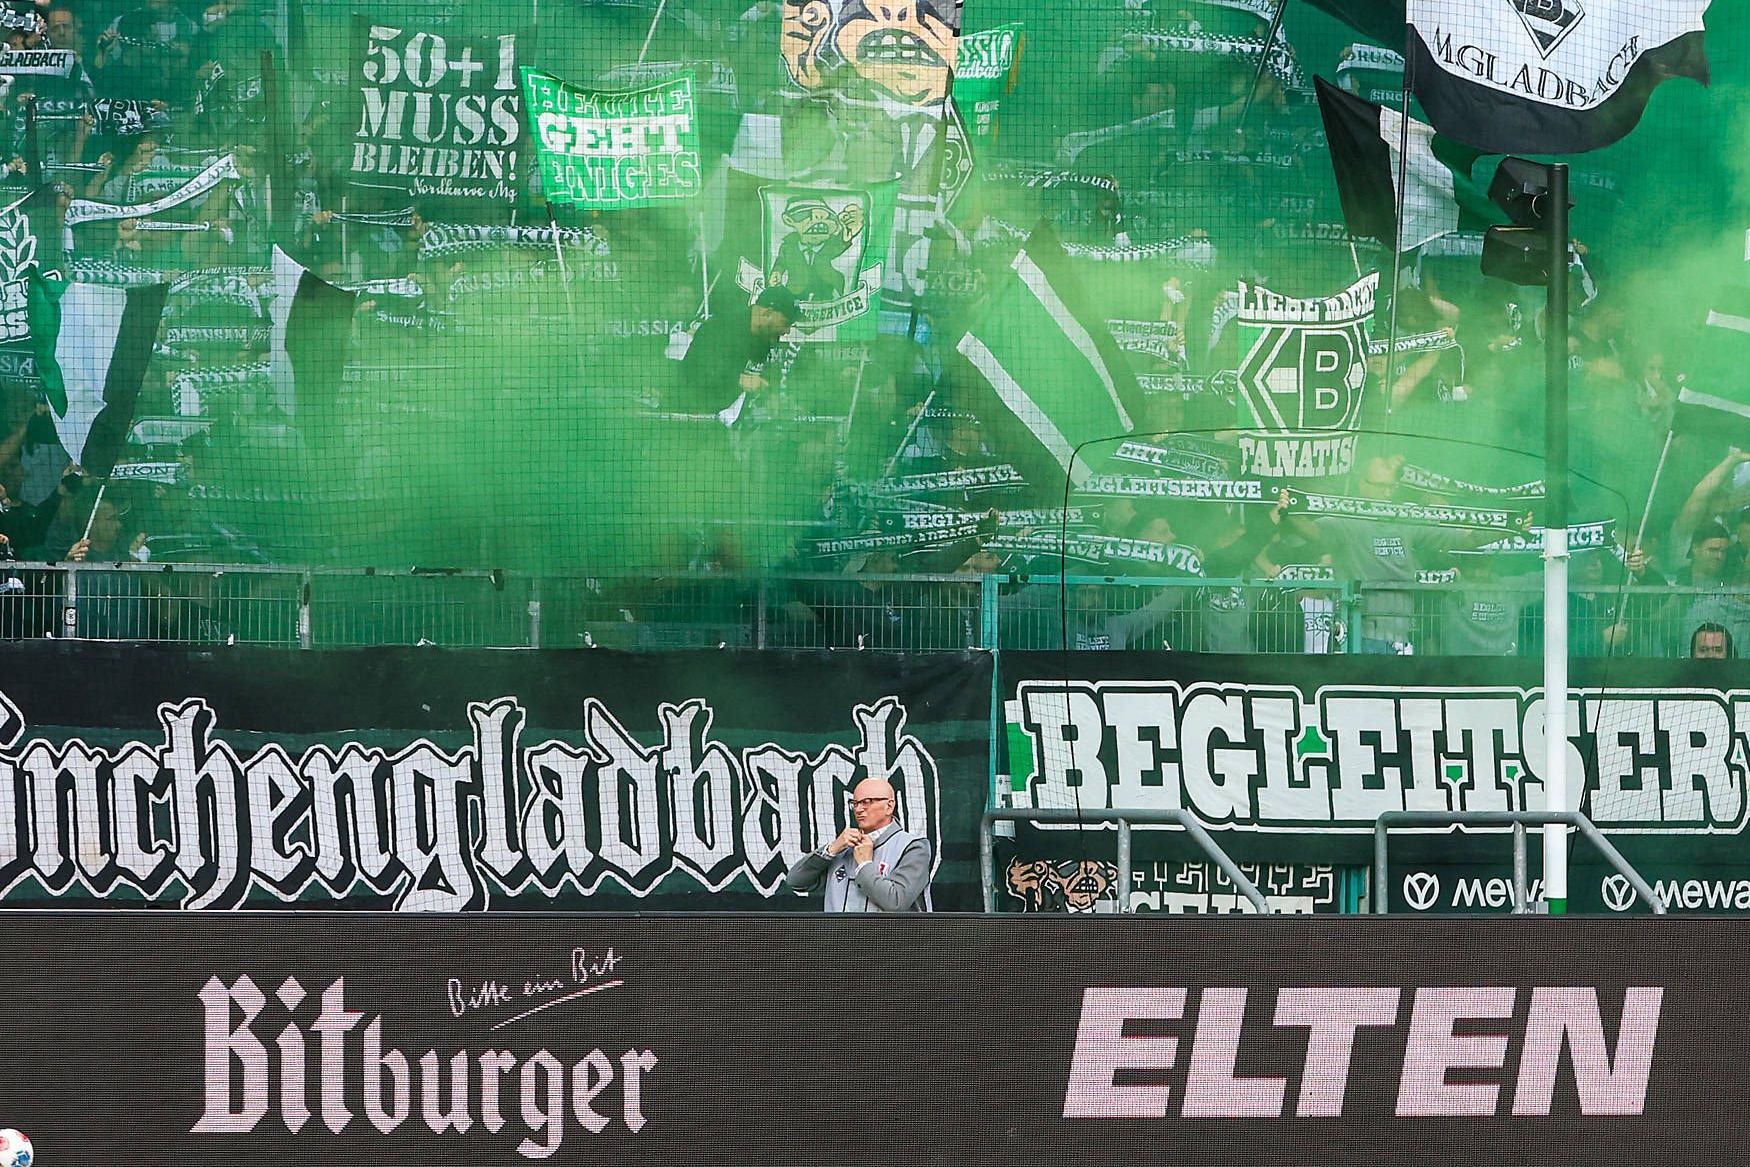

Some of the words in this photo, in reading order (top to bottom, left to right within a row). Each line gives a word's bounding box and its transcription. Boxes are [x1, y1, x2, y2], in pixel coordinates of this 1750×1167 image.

[362, 23, 519, 91] 50+1
[1431, 24, 1642, 109] M.GLADBACH
[353, 86, 521, 146] MUSS
[536, 114, 690, 153] GEHT
[350, 141, 518, 182] BLEIBEN!
[1239, 281, 1320, 322] LIEBE
[447, 973, 511, 1020] Bitte
[519, 969, 565, 997] ein
[570, 945, 626, 983] Bit
[189, 973, 659, 1160] Bitburger
[1063, 986, 1665, 1117] ELTEN
